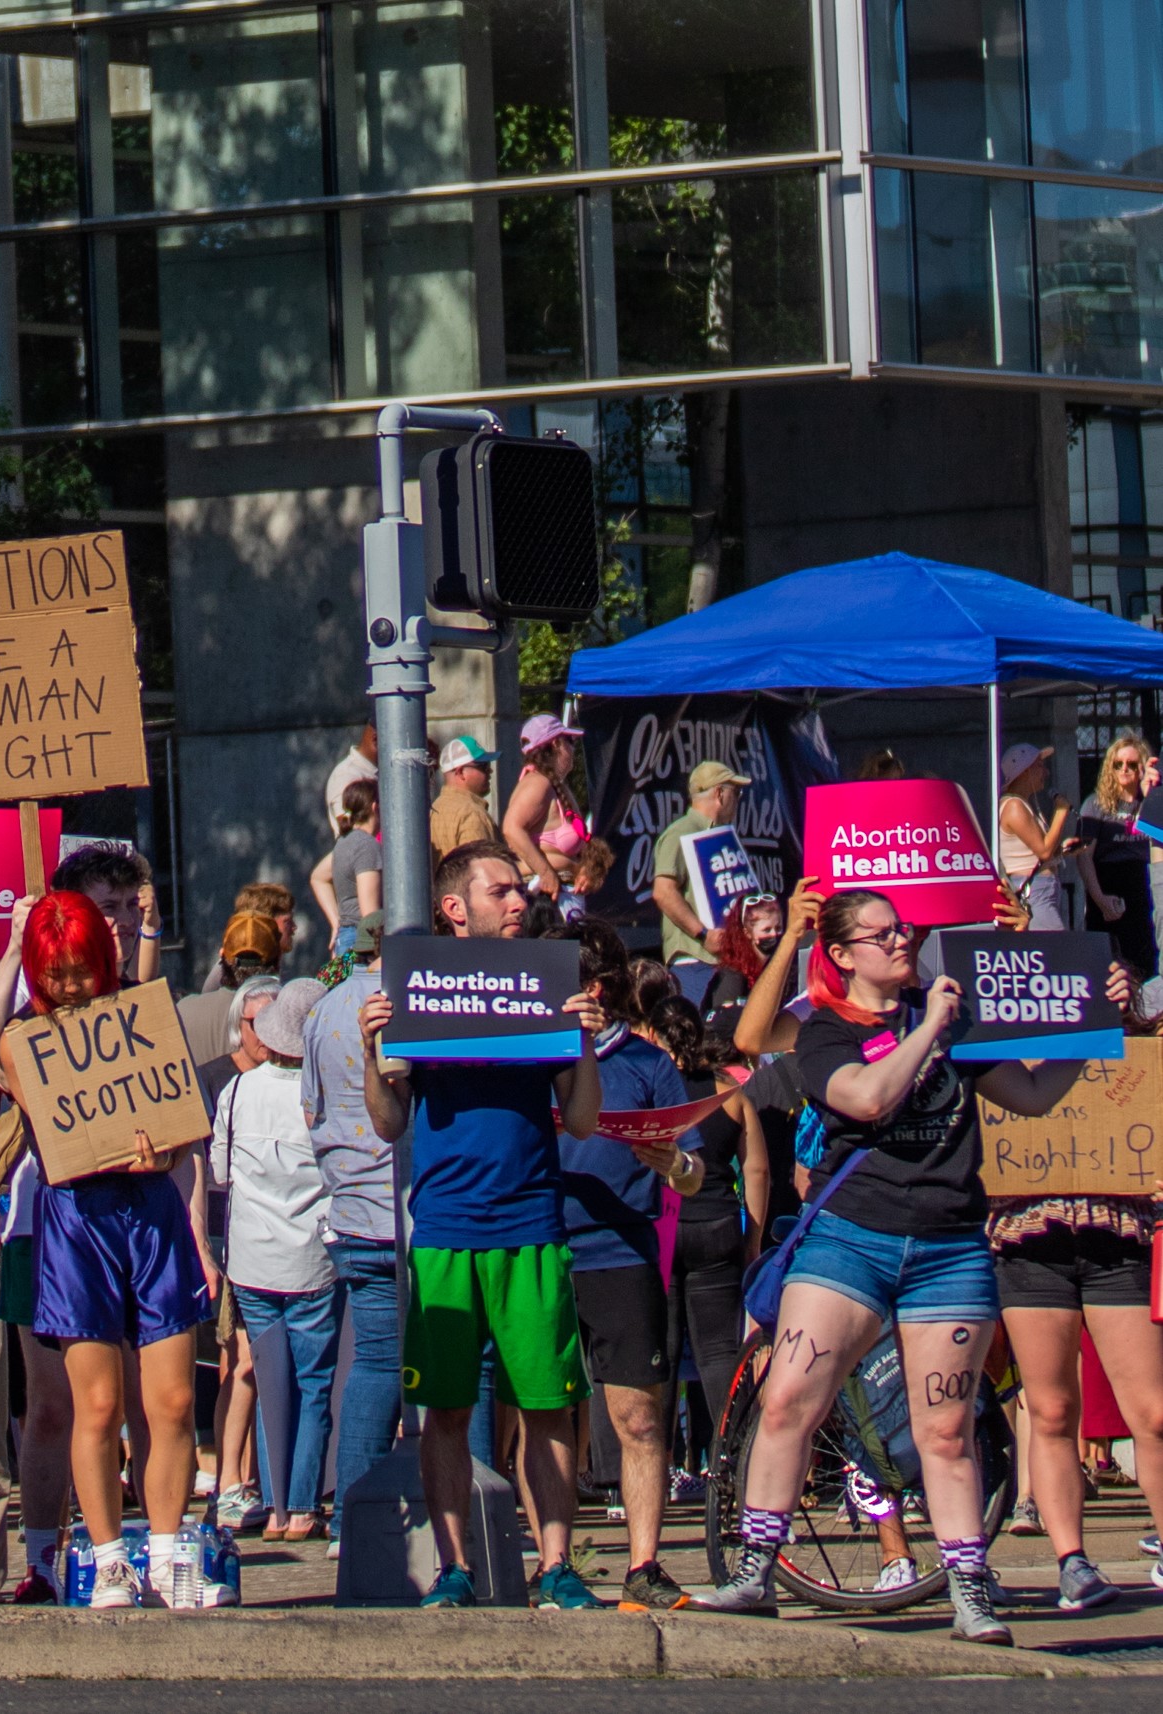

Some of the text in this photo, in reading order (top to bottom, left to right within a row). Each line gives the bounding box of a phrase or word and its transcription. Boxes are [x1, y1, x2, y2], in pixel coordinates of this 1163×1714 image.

[49, 629, 77, 667] A
[832, 821, 960, 848] Abortion is
[832, 849, 991, 877] Health Care.
[974, 951, 1044, 973] BANS
[407, 970, 540, 993] Abortion is
[976, 975, 1091, 999] OFF OUR
[409, 994, 553, 1017] Health Care.
[980, 998, 1083, 1023] BODIES
[27, 1003, 155, 1085] FUCK
[52, 1059, 191, 1133] SCOTUS!
[982, 1099, 1088, 1126] Woens
[996, 1136, 1114, 1182] Rights!
[773, 1327, 830, 1374] MY
[925, 1371, 974, 1407] BOD
